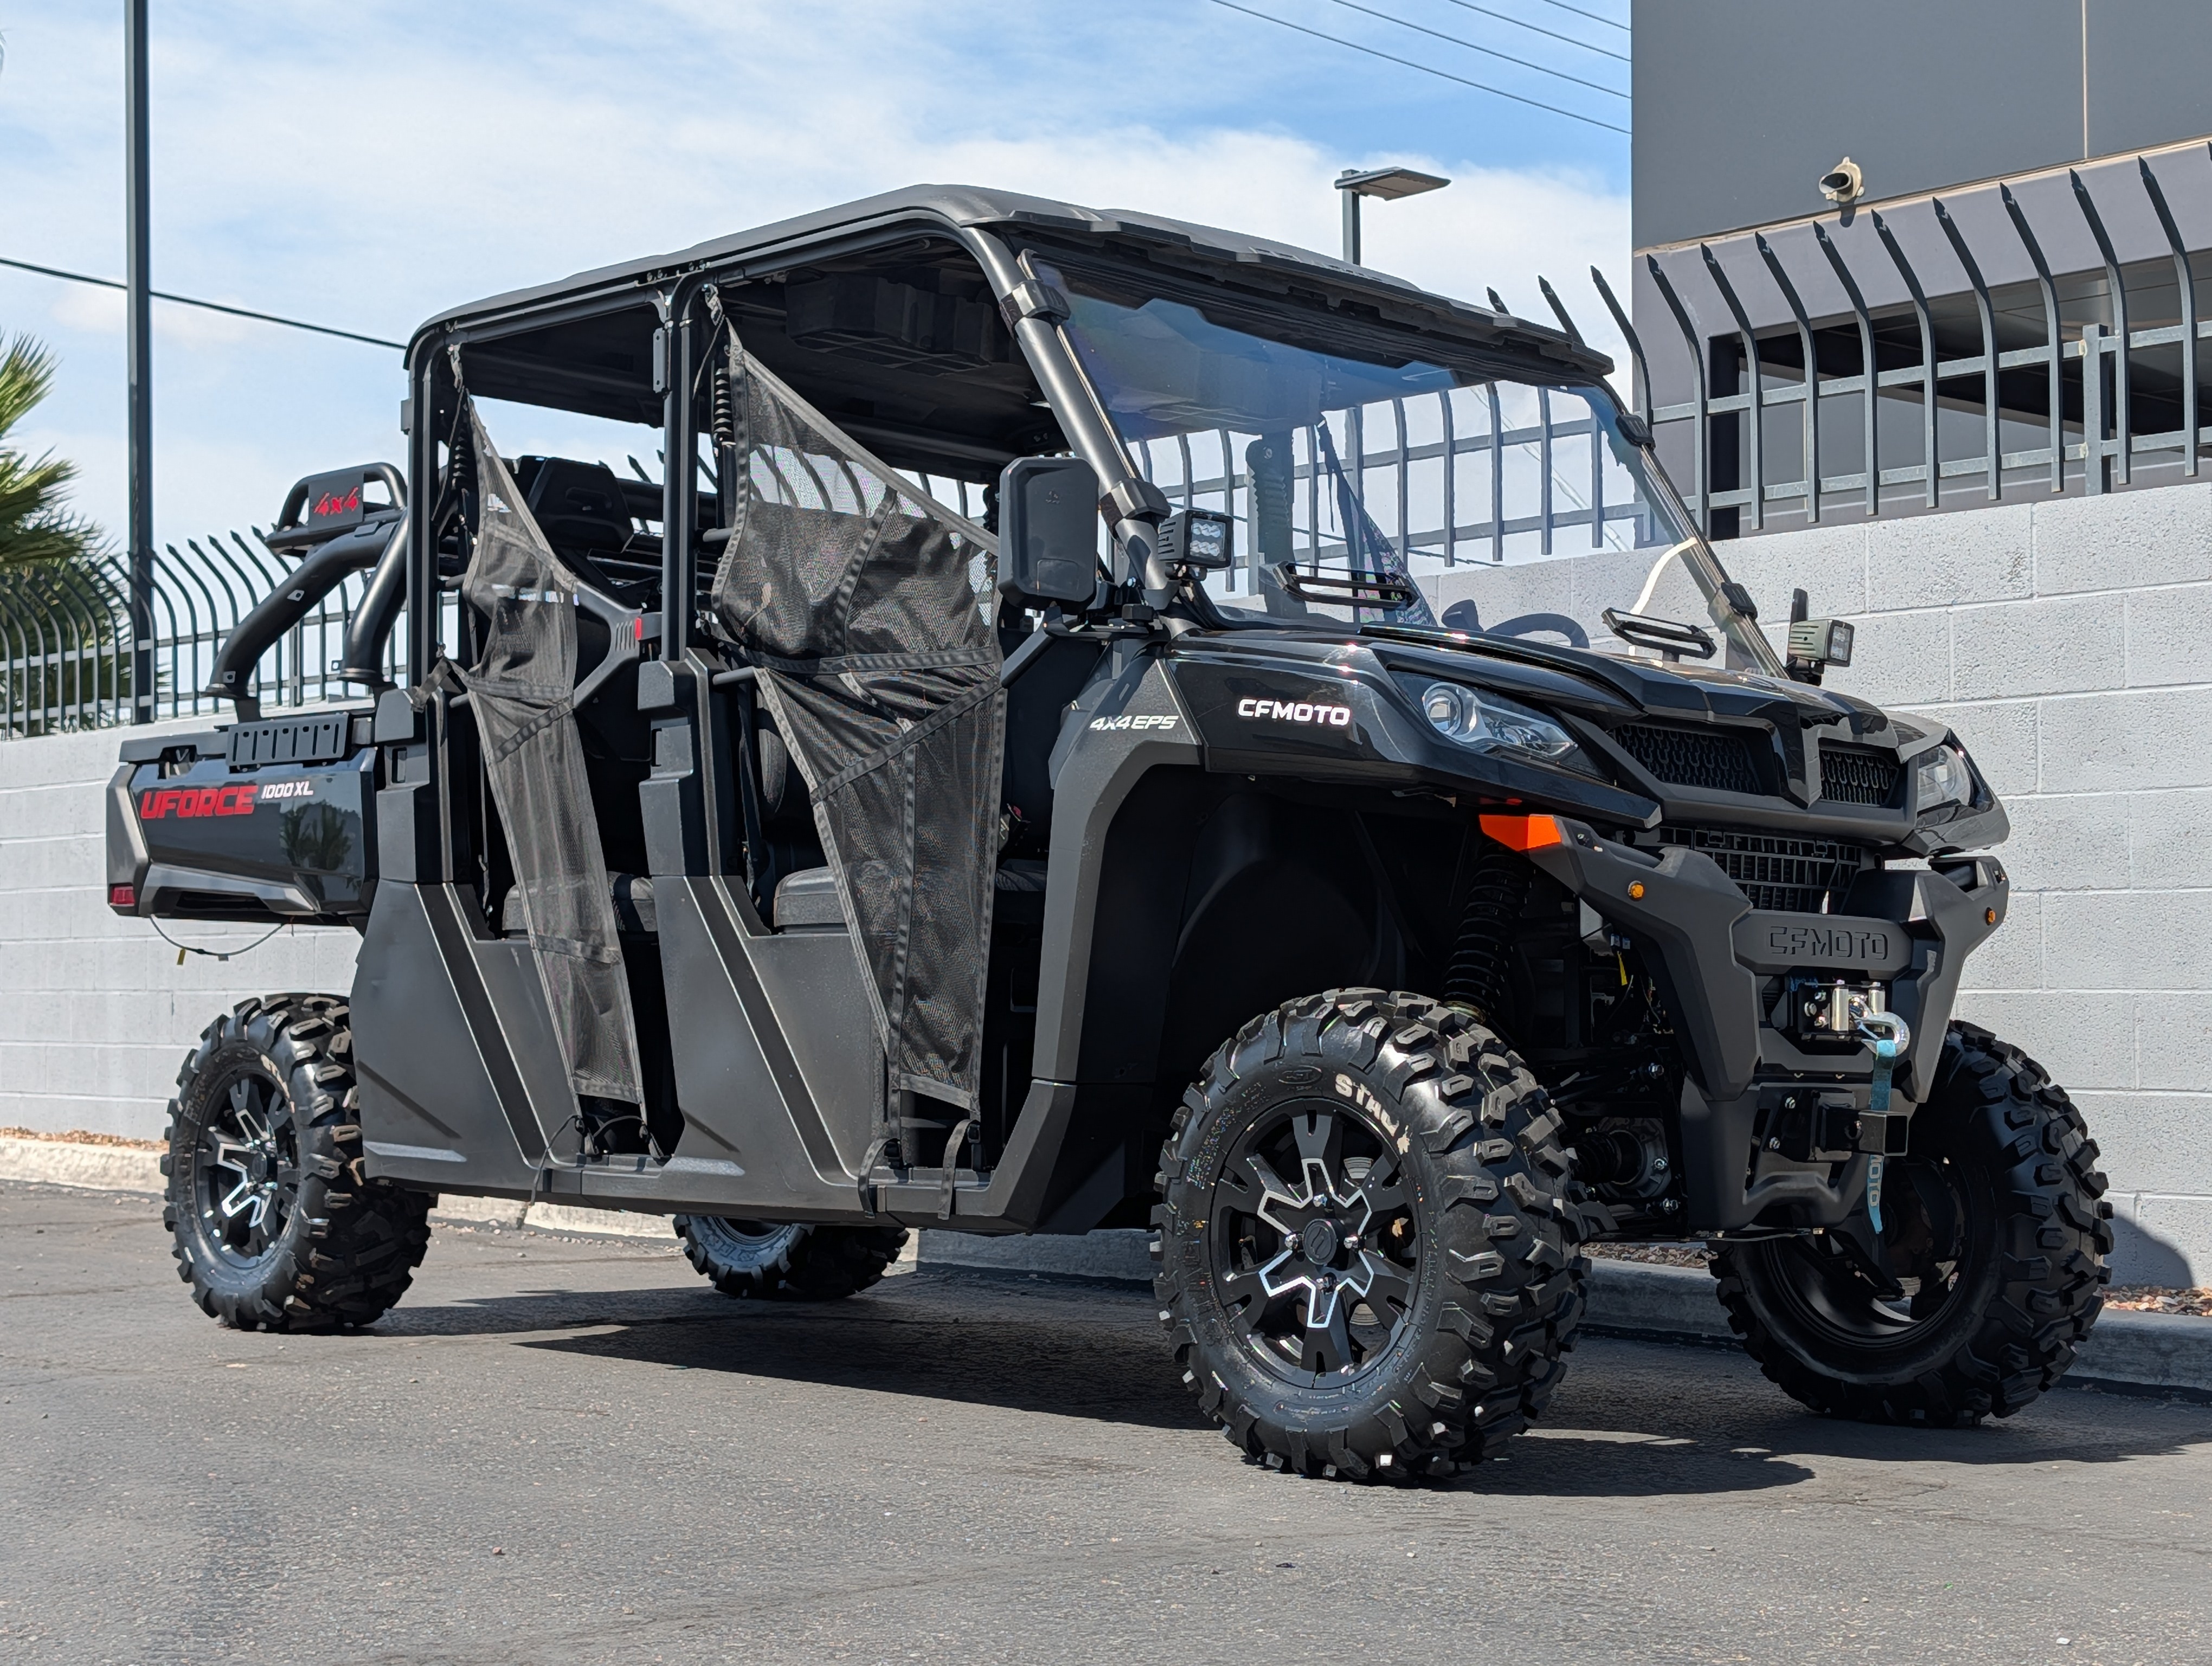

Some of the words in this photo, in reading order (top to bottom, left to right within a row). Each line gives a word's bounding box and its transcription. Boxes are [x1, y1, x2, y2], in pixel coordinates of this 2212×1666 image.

[1130, 715, 1179, 730] EPS
[1237, 699, 1351, 726] CFMOTO
[140, 785, 259, 819] UFORCE
[261, 784, 294, 799] 1000
[293, 780, 314, 796] XL
[1770, 926, 1889, 960] CFMOTO
